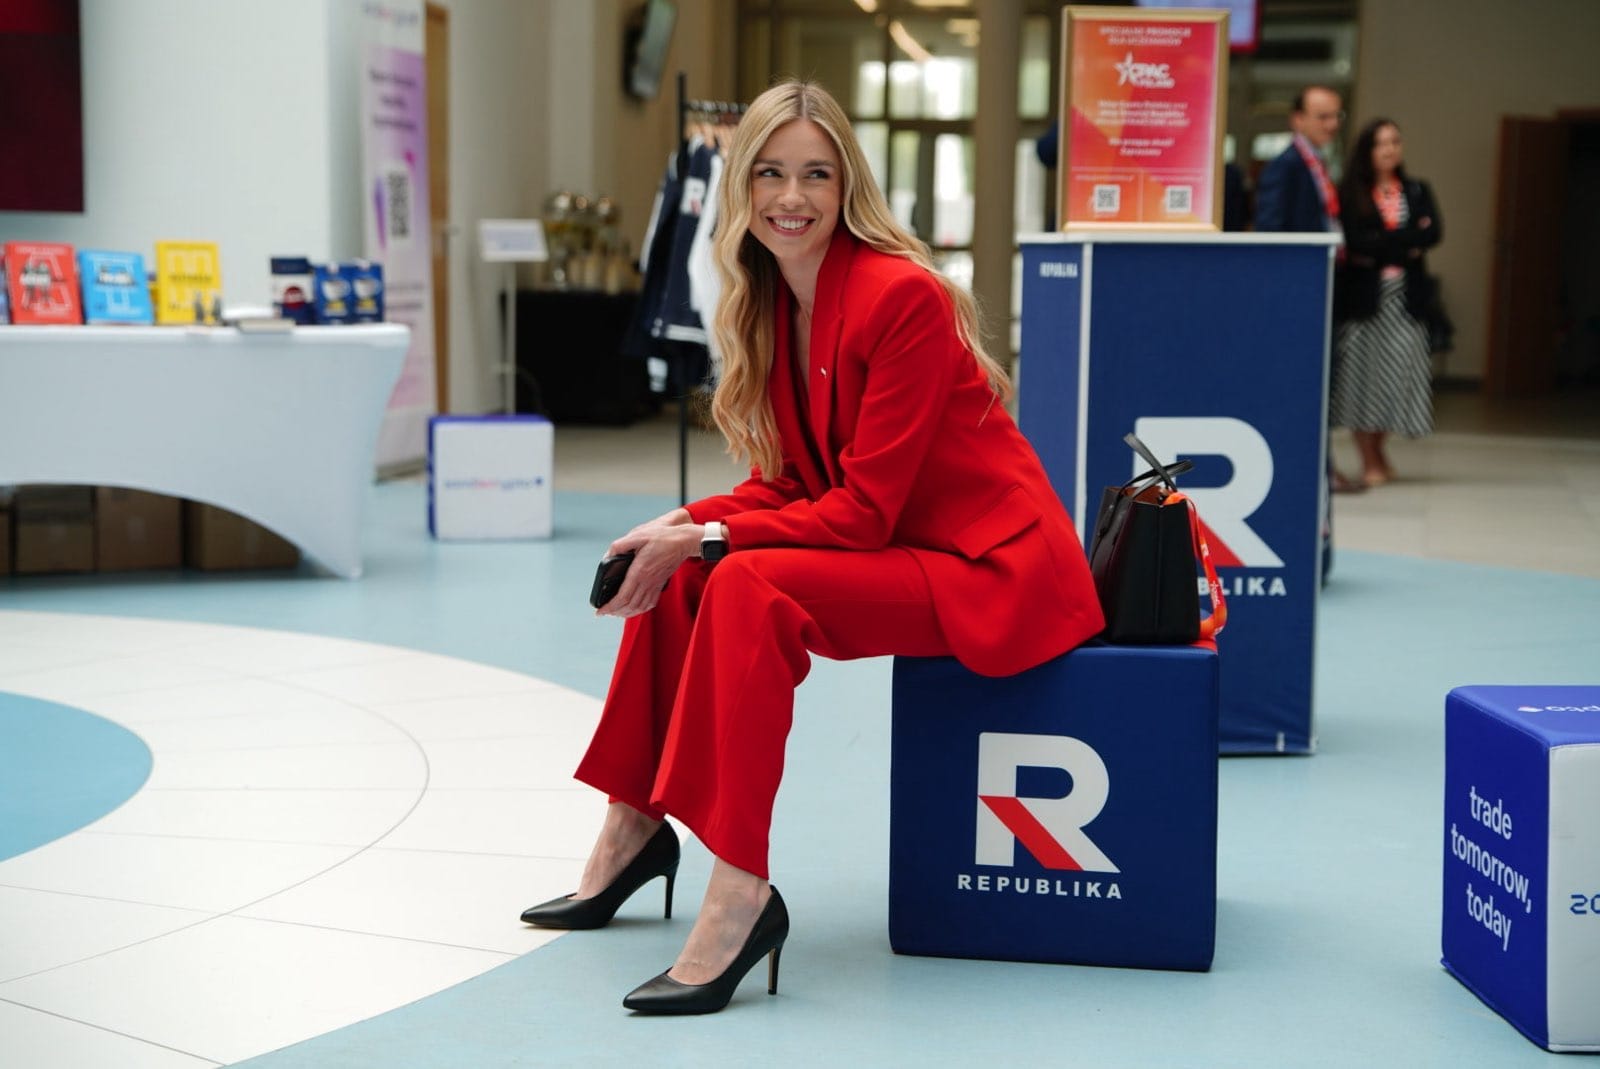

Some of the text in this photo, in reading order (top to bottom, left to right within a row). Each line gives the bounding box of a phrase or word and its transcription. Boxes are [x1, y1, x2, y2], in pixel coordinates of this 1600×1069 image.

[974, 732, 1121, 874] R
[1469, 786, 1513, 840] trade
[957, 874, 1122, 900] REPUBLIKA
[1450, 823, 1532, 914] tomorrow,
[1466, 883, 1512, 952] today
